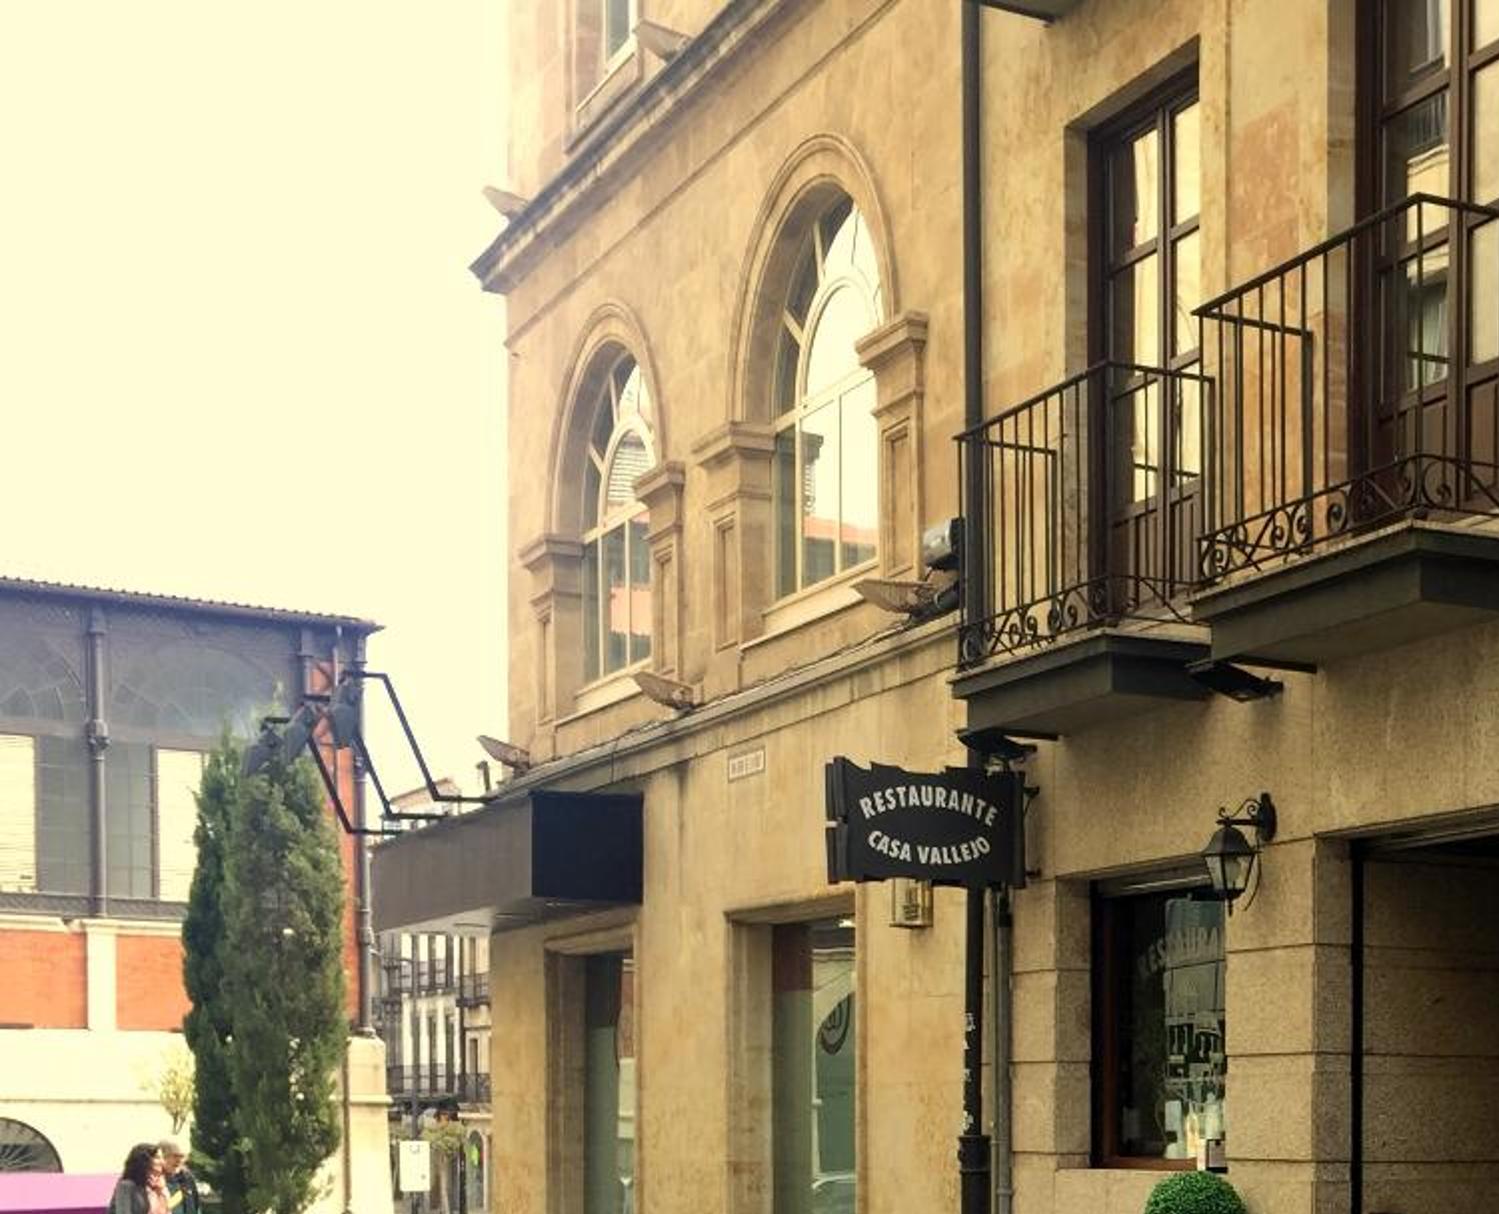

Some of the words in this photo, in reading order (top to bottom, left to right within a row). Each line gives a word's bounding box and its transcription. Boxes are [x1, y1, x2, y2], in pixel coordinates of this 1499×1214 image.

[859, 785, 998, 826] RESTAURANTE
[867, 830, 912, 863] CASA
[917, 836, 991, 865] VALLEJO
